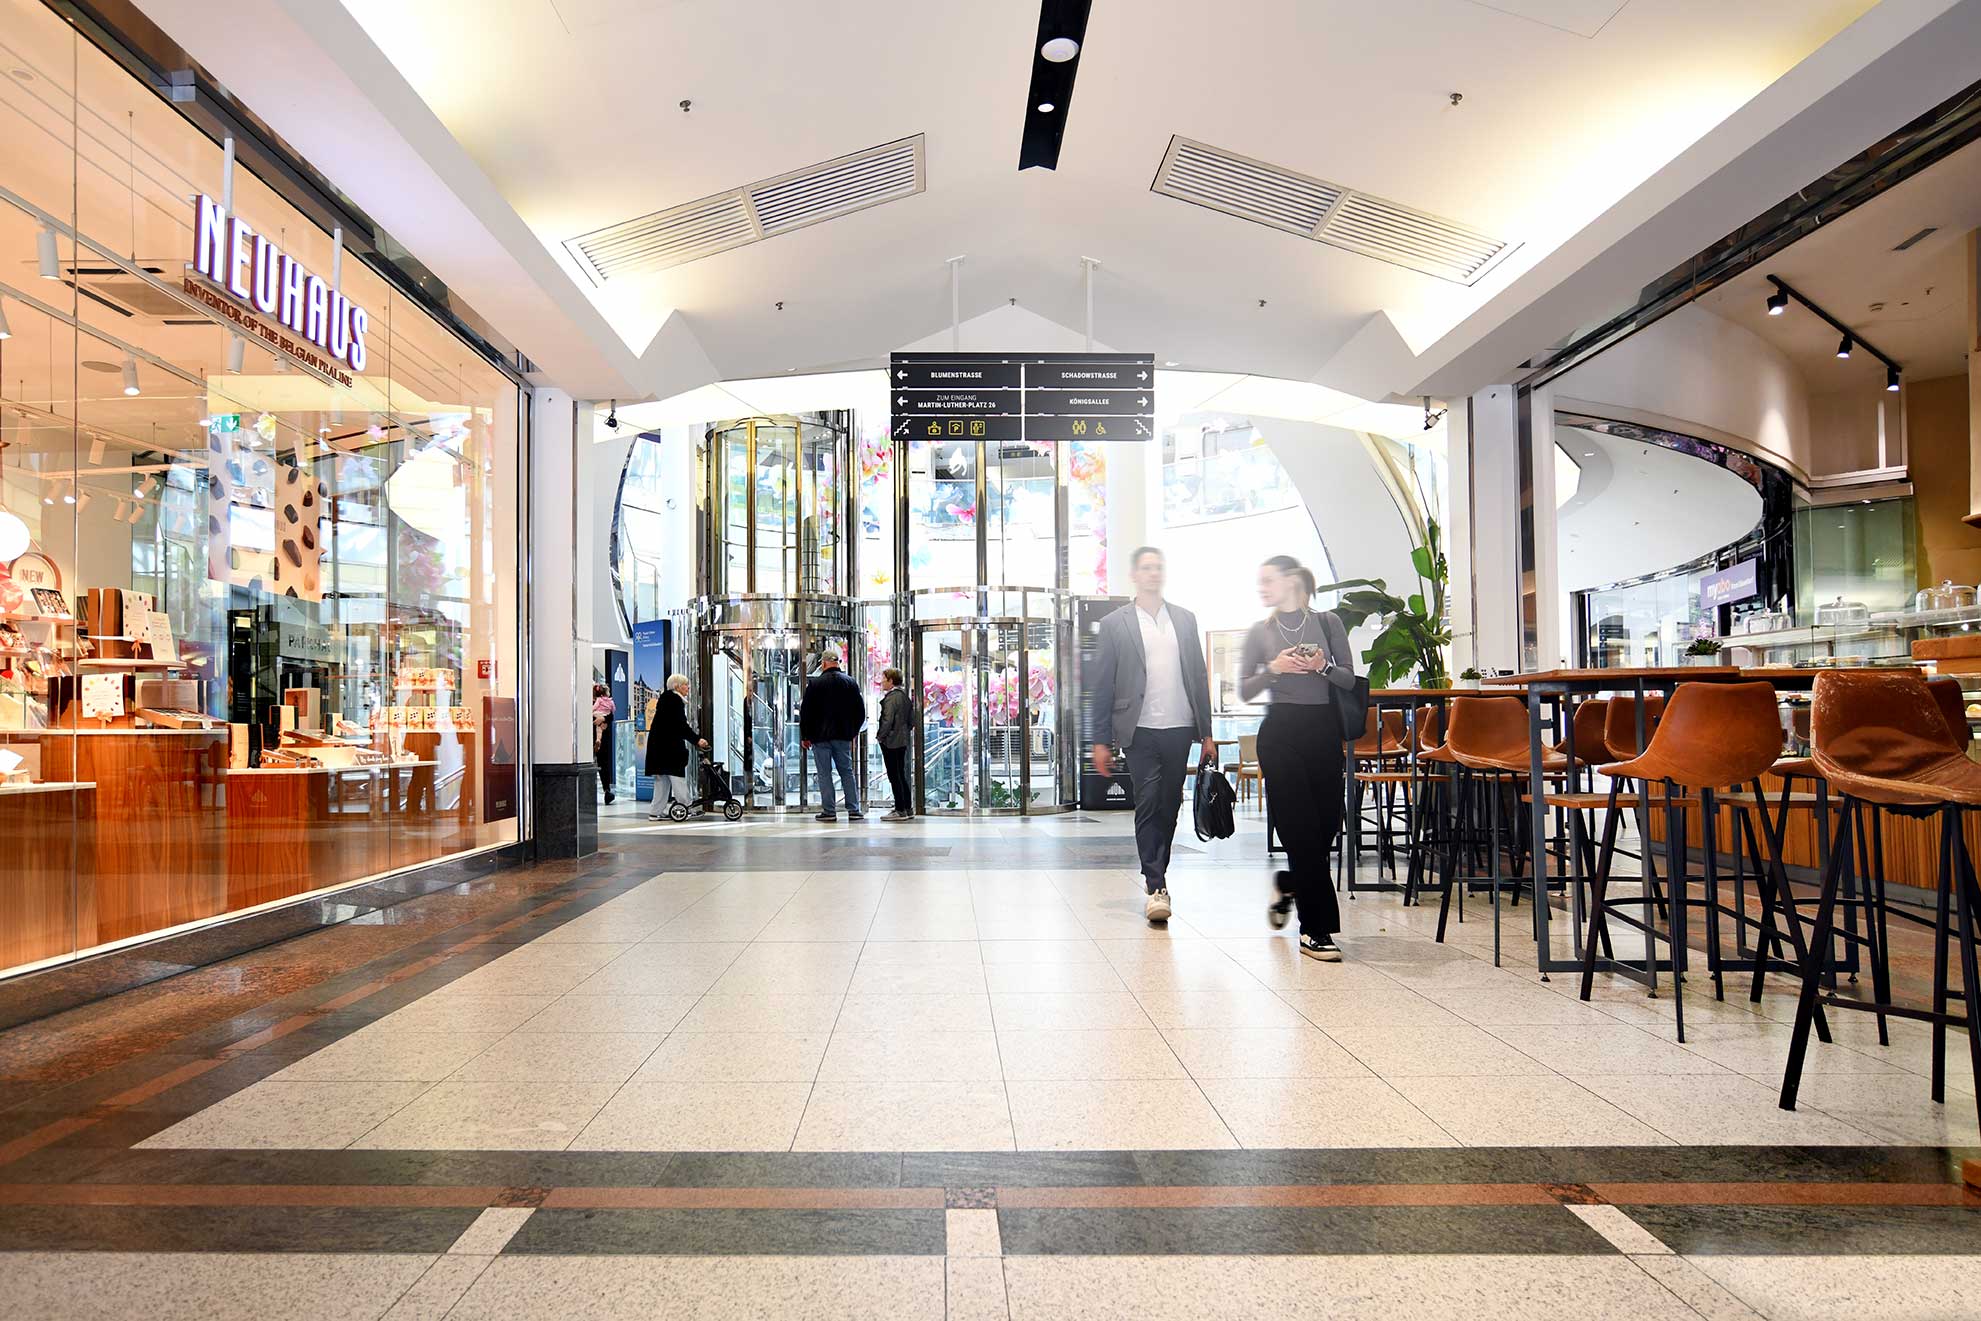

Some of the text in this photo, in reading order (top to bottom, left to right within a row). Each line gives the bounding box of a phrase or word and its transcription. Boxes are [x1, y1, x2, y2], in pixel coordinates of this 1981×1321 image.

[193, 194, 368, 372] NEUHAUS
[184, 278, 353, 389] INVENTOR OF THE BELGIAN PRALINE
[930, 371, 983, 379] BLUMENSTRASSE
[1069, 397, 1110, 405] KÖNIGSALLEE
[20, 569, 44, 583] NEW
